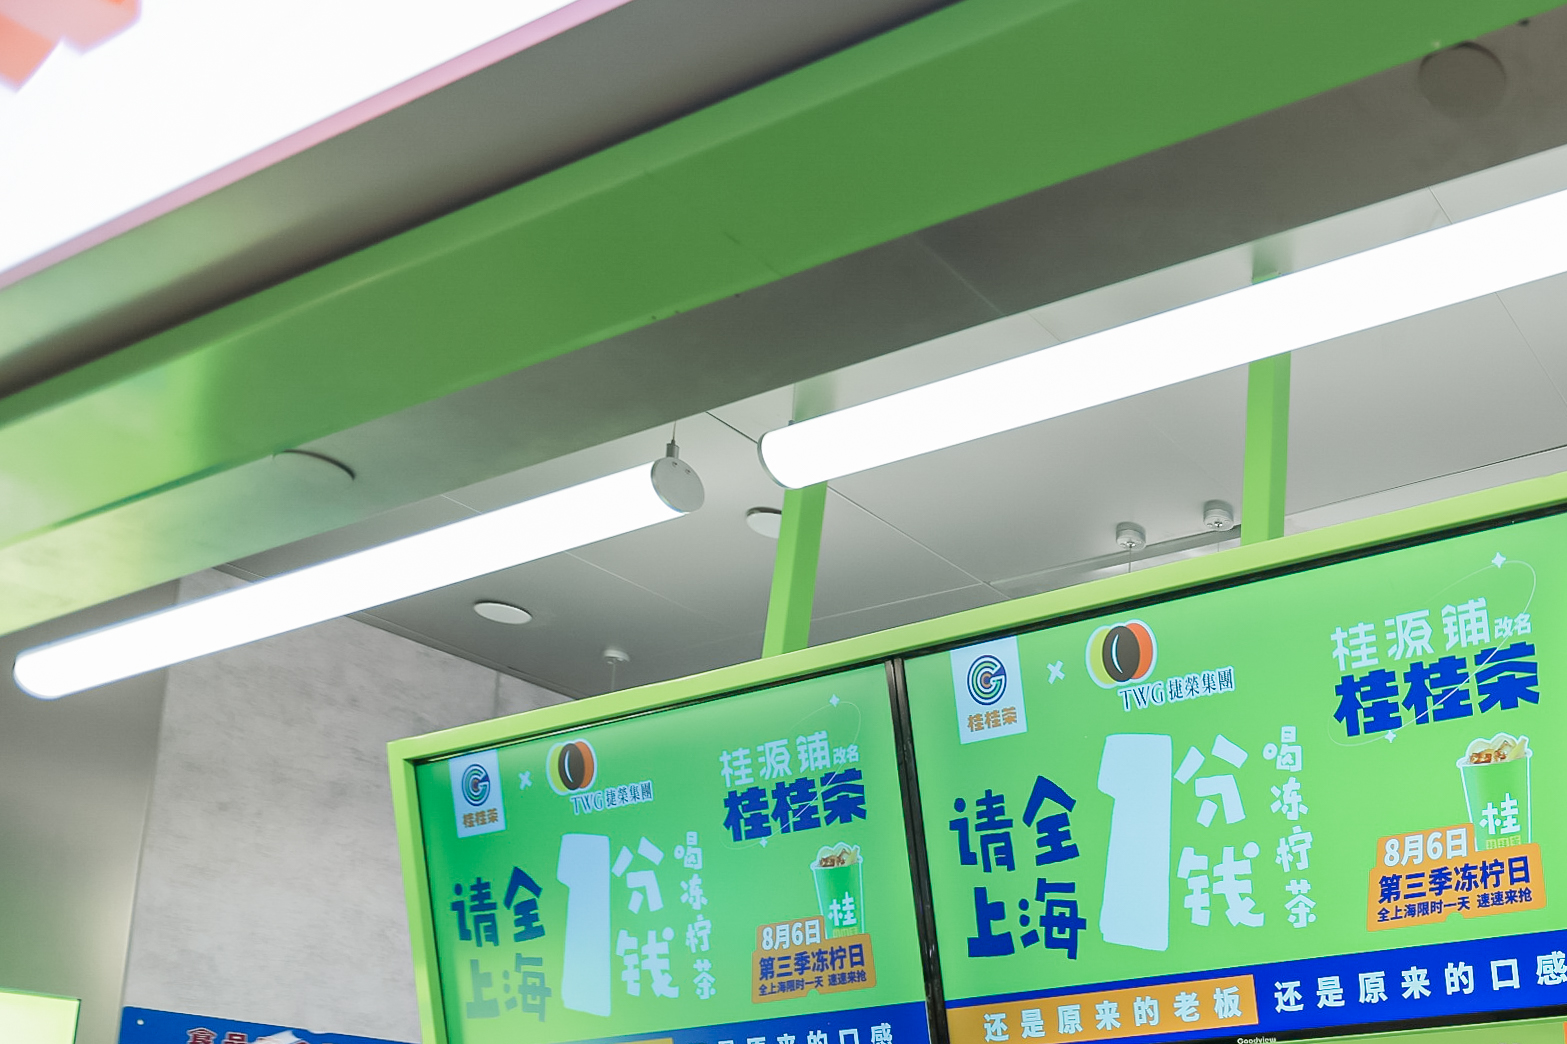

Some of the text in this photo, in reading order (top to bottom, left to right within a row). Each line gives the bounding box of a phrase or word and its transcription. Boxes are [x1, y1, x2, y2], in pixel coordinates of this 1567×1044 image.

[1119, 667, 1234, 711] TWG 捷榮集團
[1333, 641, 1540, 738] 桂桂茶
[967, 706, 1018, 733] 桂桂茶
[571, 793, 603, 815] TWG
[722, 767, 867, 843] 桂桂茶
[948, 774, 1081, 874] 请全
[1263, 725, 1318, 930] 喝冻柠茶
[1479, 792, 1521, 835] 桂
[1383, 827, 1468, 868] 8月6日
[1378, 855, 1531, 904] 第三季冻柠日
[450, 866, 547, 949] 请全
[674, 831, 717, 1000] 喝冻柠茶
[828, 891, 858, 927] 桂
[966, 876, 1088, 960] 上海
[761, 919, 821, 951] 8月6日
[463, 951, 553, 1022] 上海
[758, 943, 865, 981] 第三季冻柠日
[982, 986, 1243, 1044] 还是原来的老板
